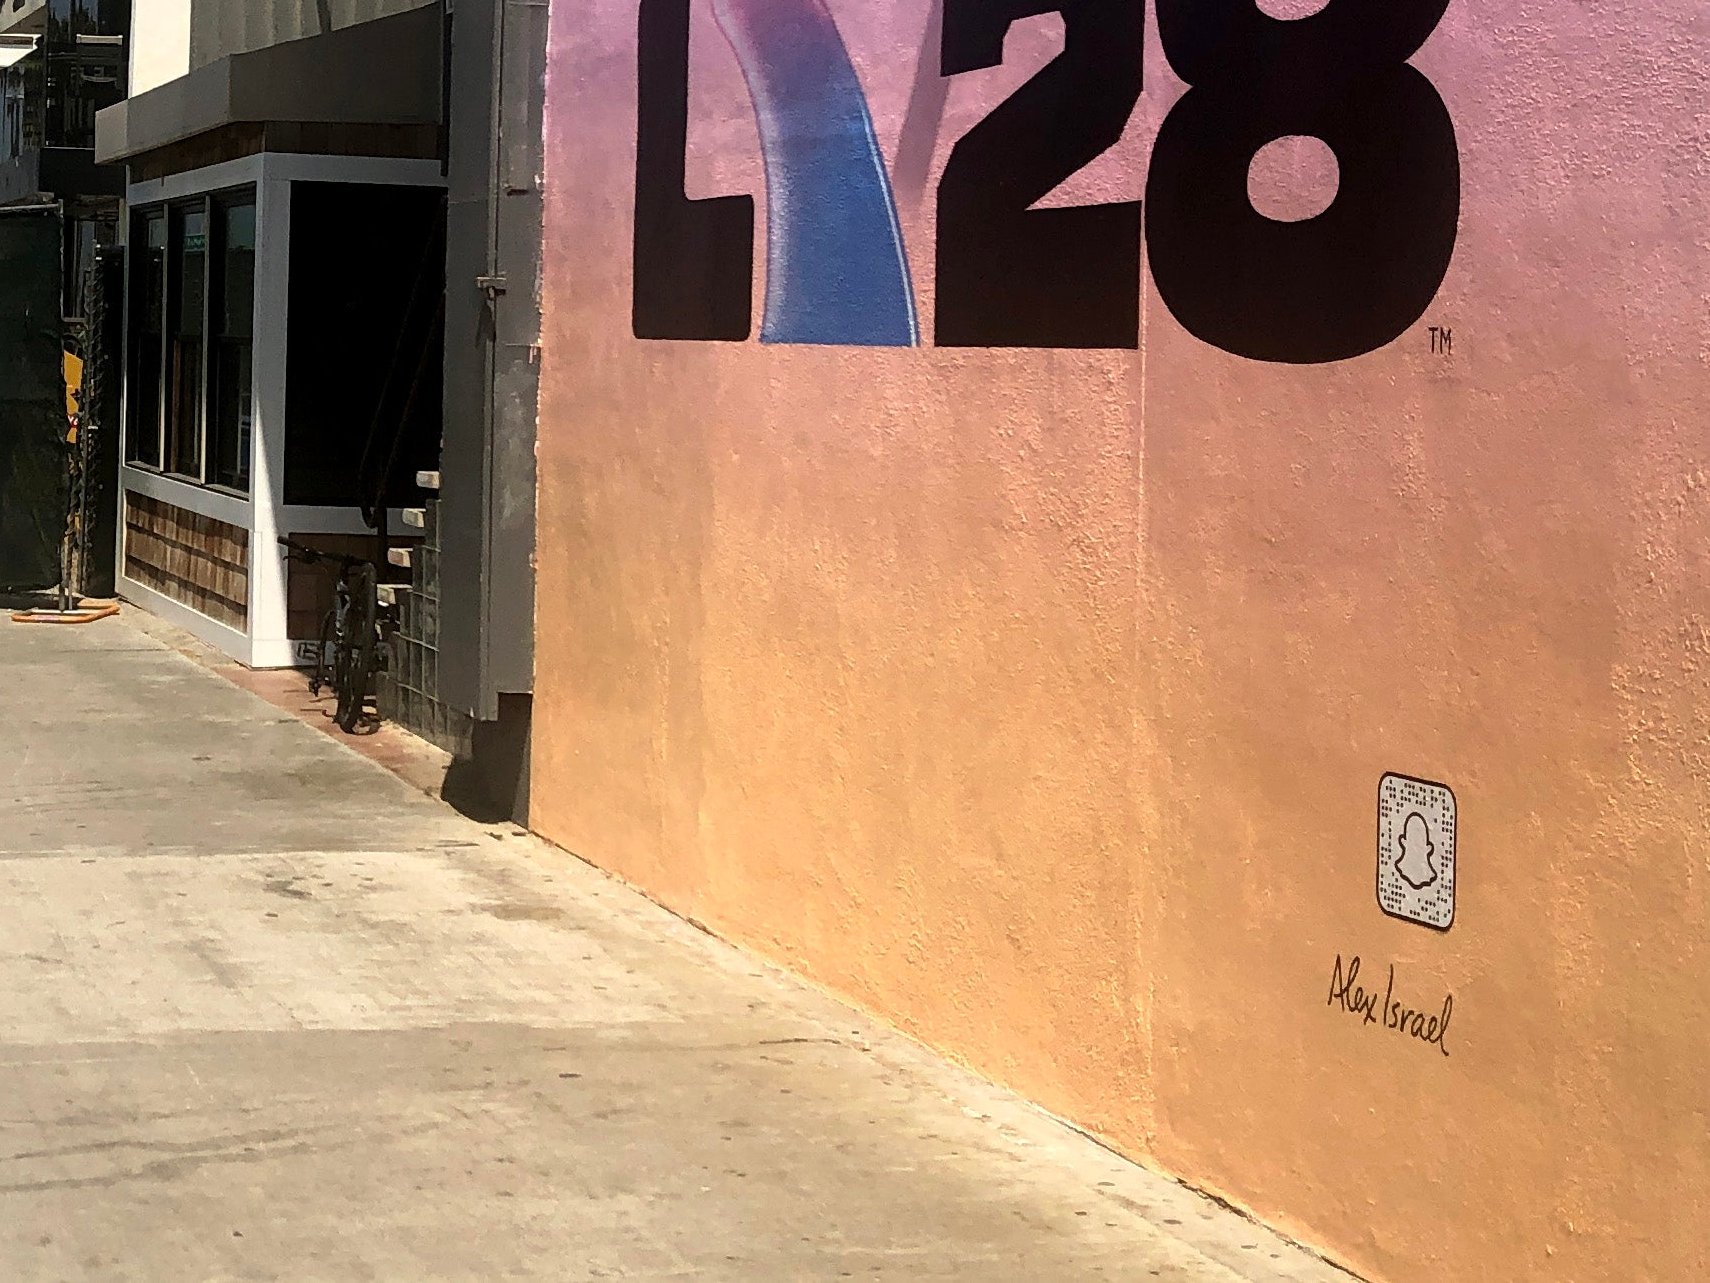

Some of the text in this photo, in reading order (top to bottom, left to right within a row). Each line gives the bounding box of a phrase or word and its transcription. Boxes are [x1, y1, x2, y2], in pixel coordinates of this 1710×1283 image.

[1428, 326, 1452, 355] TM
[1327, 953, 1453, 1057] Alex Israel
